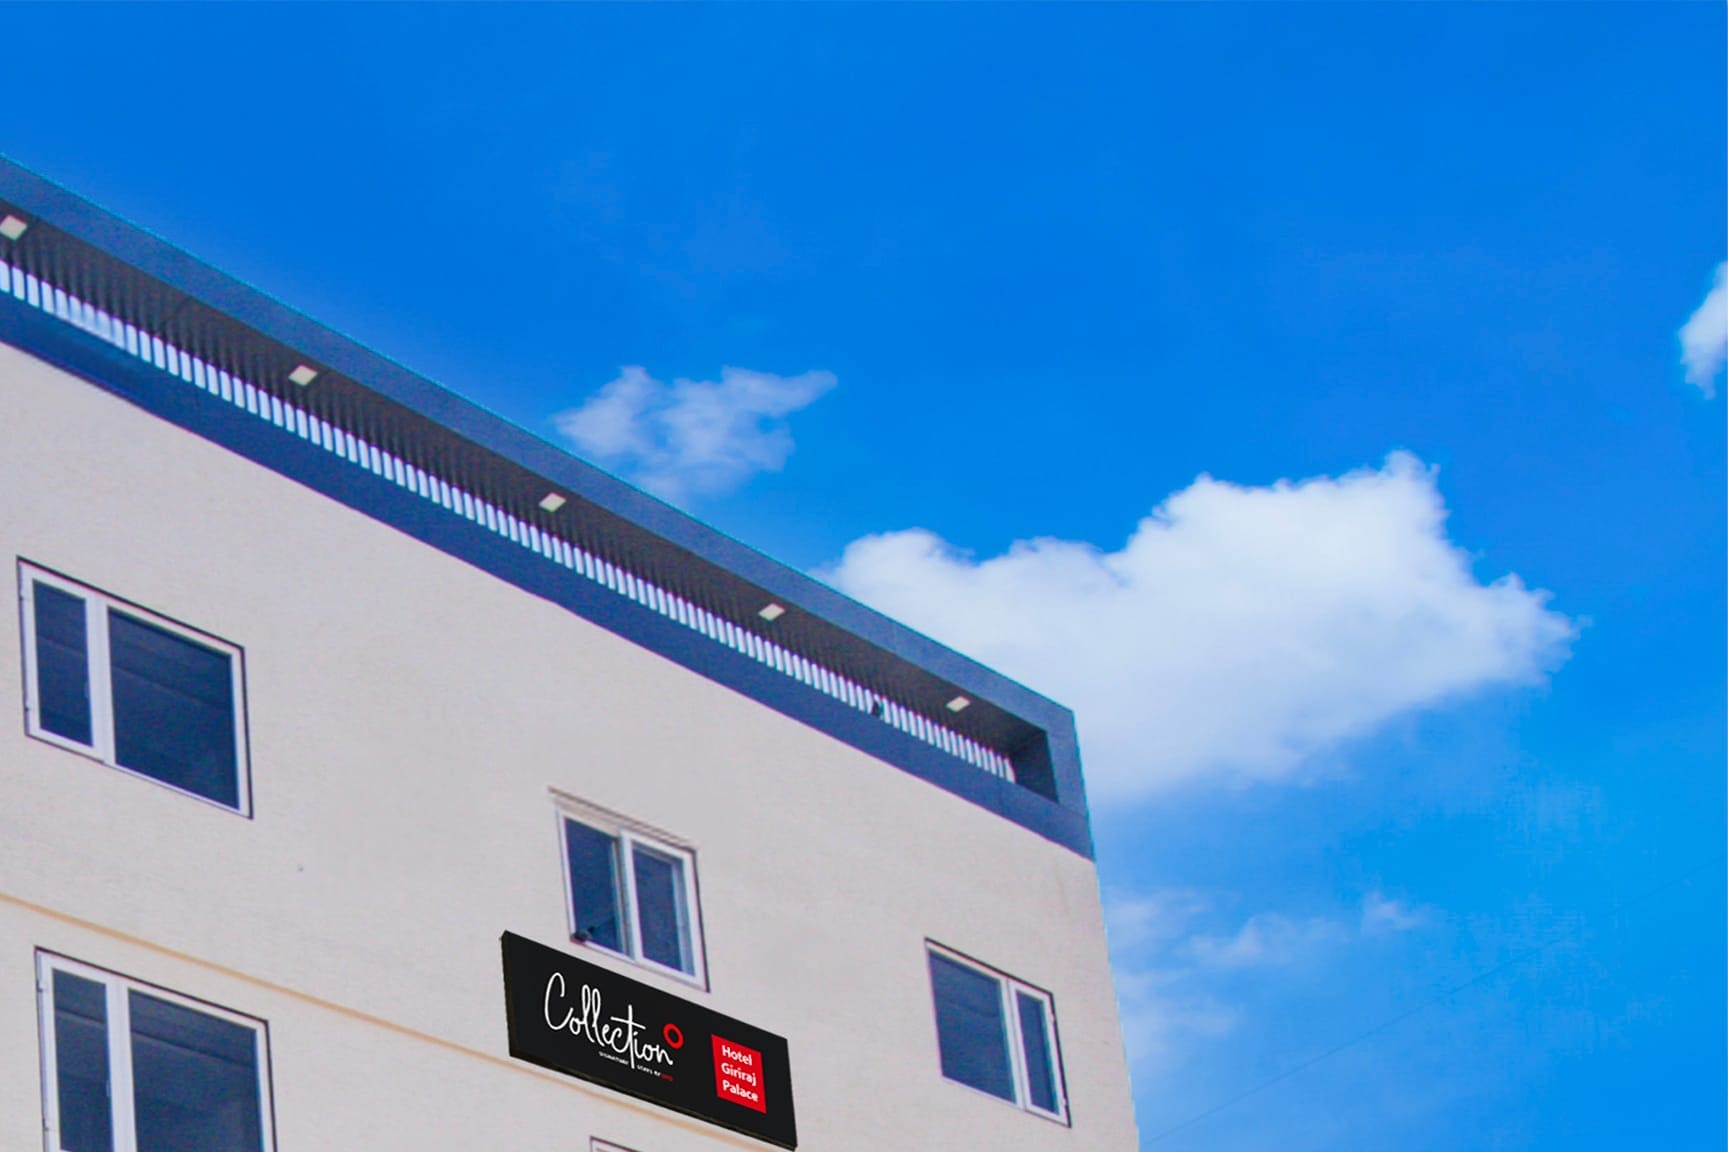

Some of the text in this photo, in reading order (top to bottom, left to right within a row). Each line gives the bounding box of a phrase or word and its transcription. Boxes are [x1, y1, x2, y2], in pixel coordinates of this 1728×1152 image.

[544, 972, 674, 1069] Collection
[721, 1044, 753, 1066] Hotel
[721, 1062, 757, 1087] Giriraj
[722, 1079, 759, 1103] Palace
